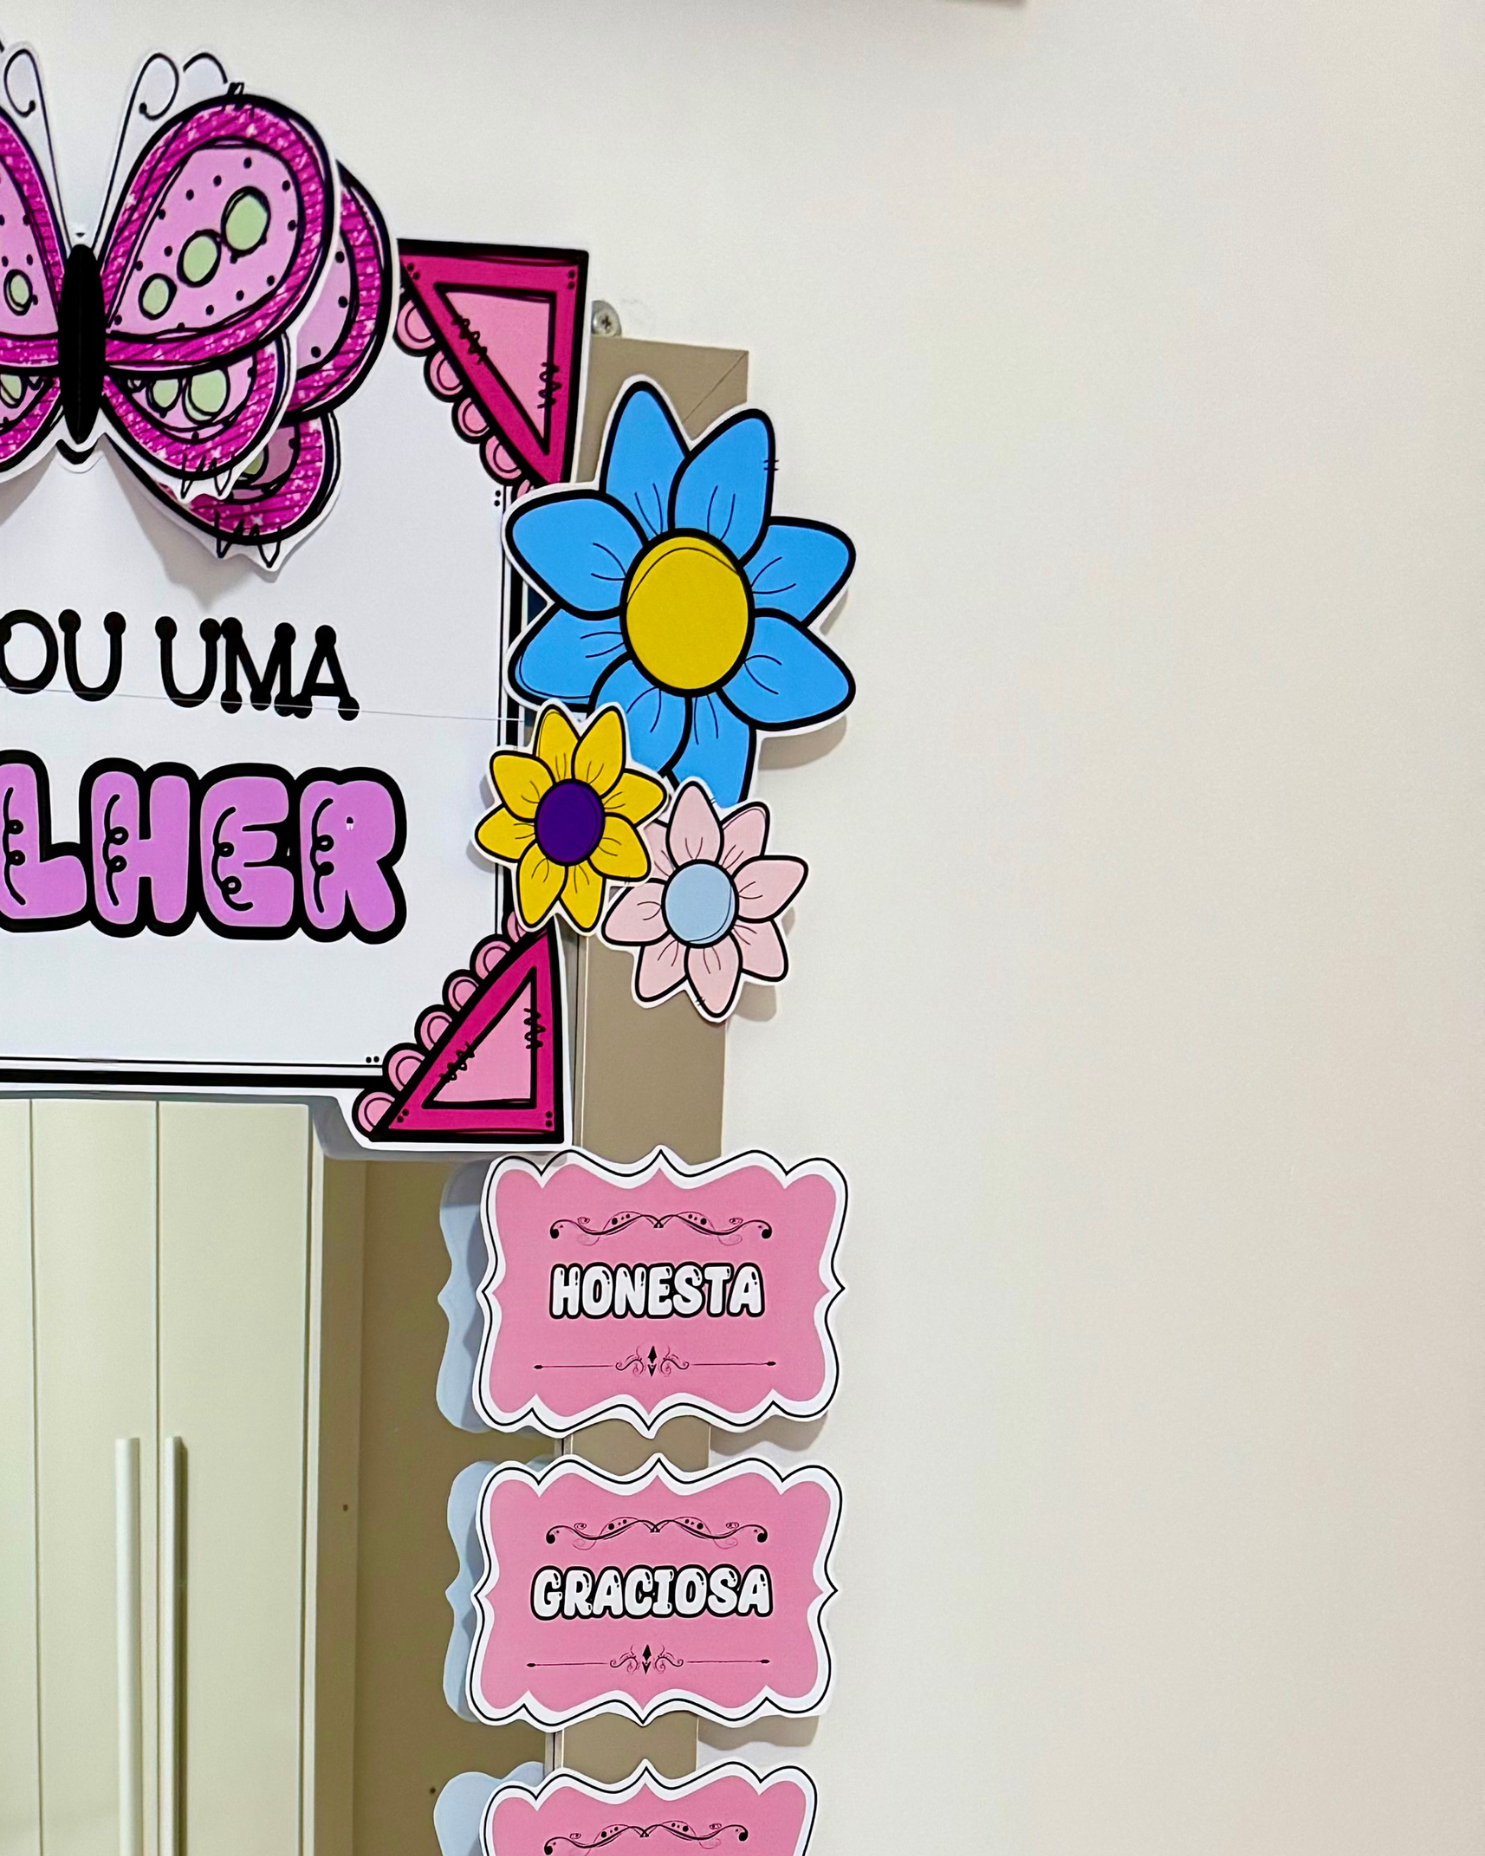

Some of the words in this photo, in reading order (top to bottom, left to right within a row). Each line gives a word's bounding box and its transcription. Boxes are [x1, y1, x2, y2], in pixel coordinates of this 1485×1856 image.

[154, 616, 359, 721] UMA
[549, 1262, 765, 1319] HONESTA
[531, 1564, 773, 1620] GRACIOSA
